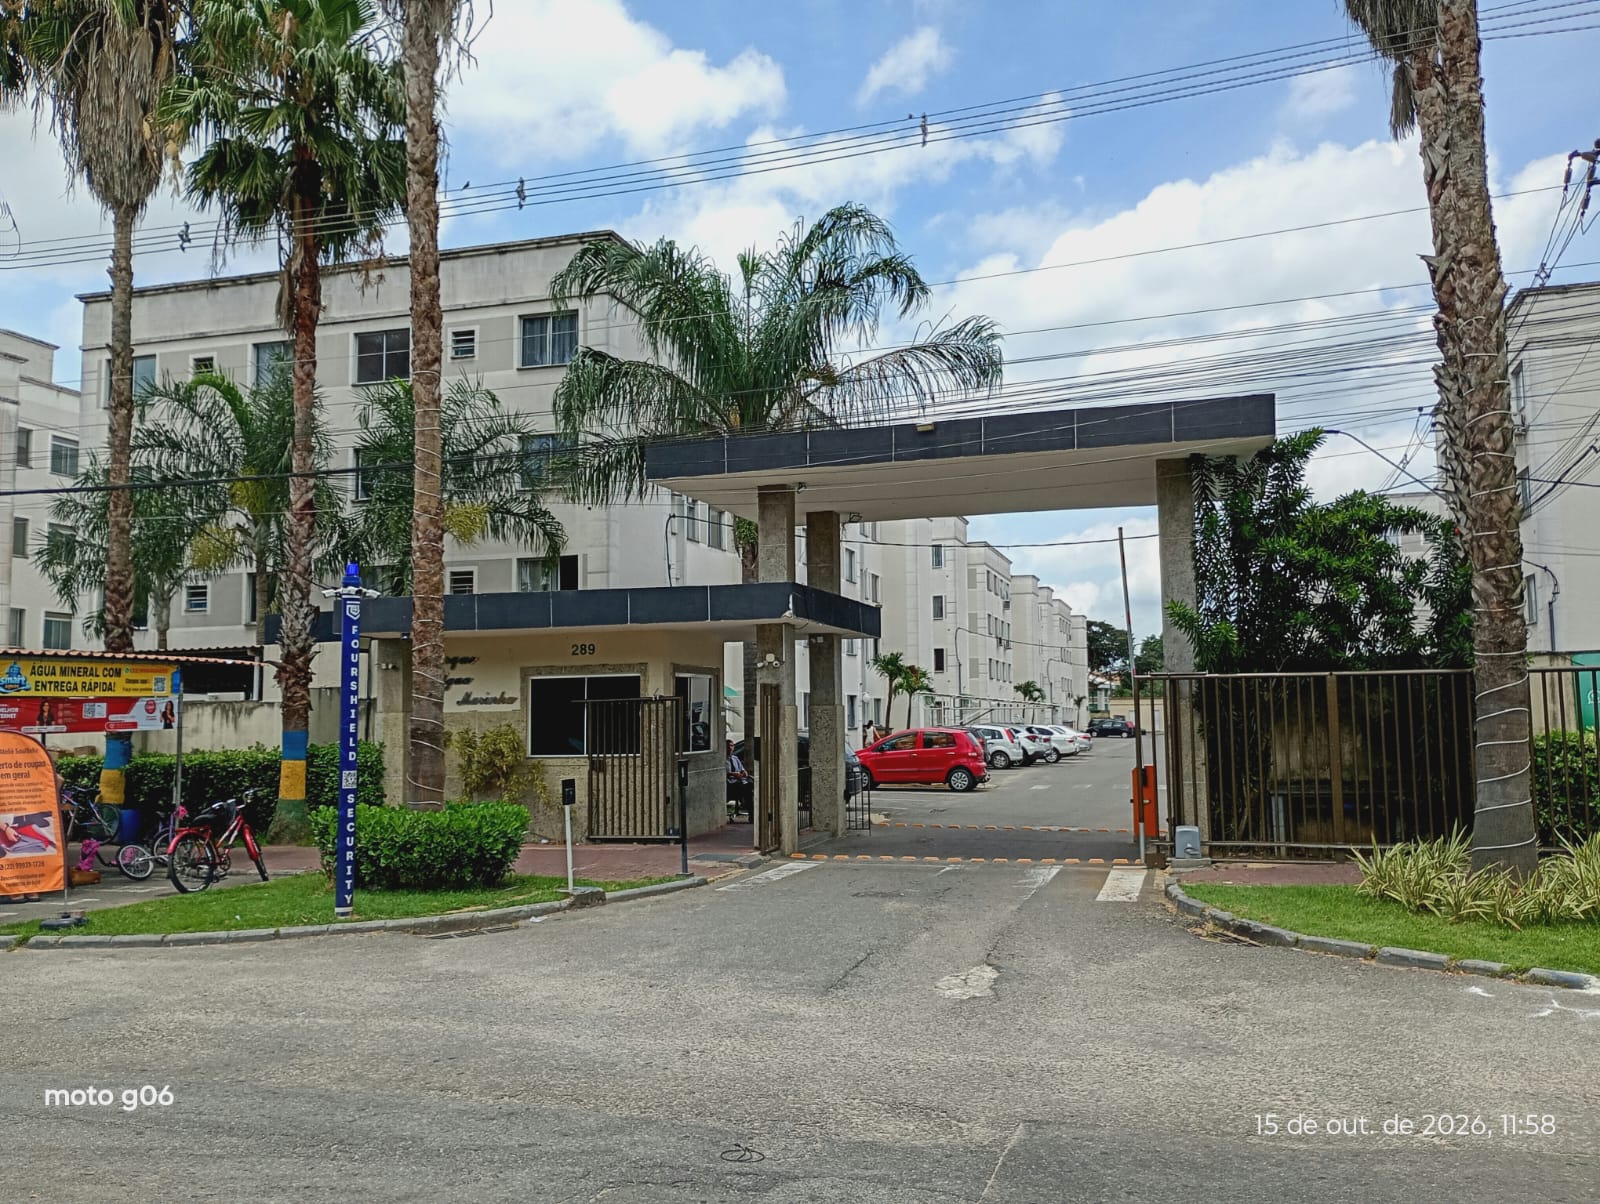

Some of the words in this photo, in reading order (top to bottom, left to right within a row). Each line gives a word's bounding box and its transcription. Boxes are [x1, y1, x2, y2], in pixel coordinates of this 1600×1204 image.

[571, 643, 596, 656] 289
[30, 662, 57, 677] ÁGUA
[60, 665, 100, 678] MINERAL
[102, 667, 122, 678] COM
[34, 680, 79, 692] ENTREGA
[81, 678, 116, 692] RÁPIDA!
[348, 625, 360, 761] FOURSHIELD
[13, 760, 22, 769] de
[12, 770, 31, 781] geral
[344, 793, 356, 905] SECURITY
